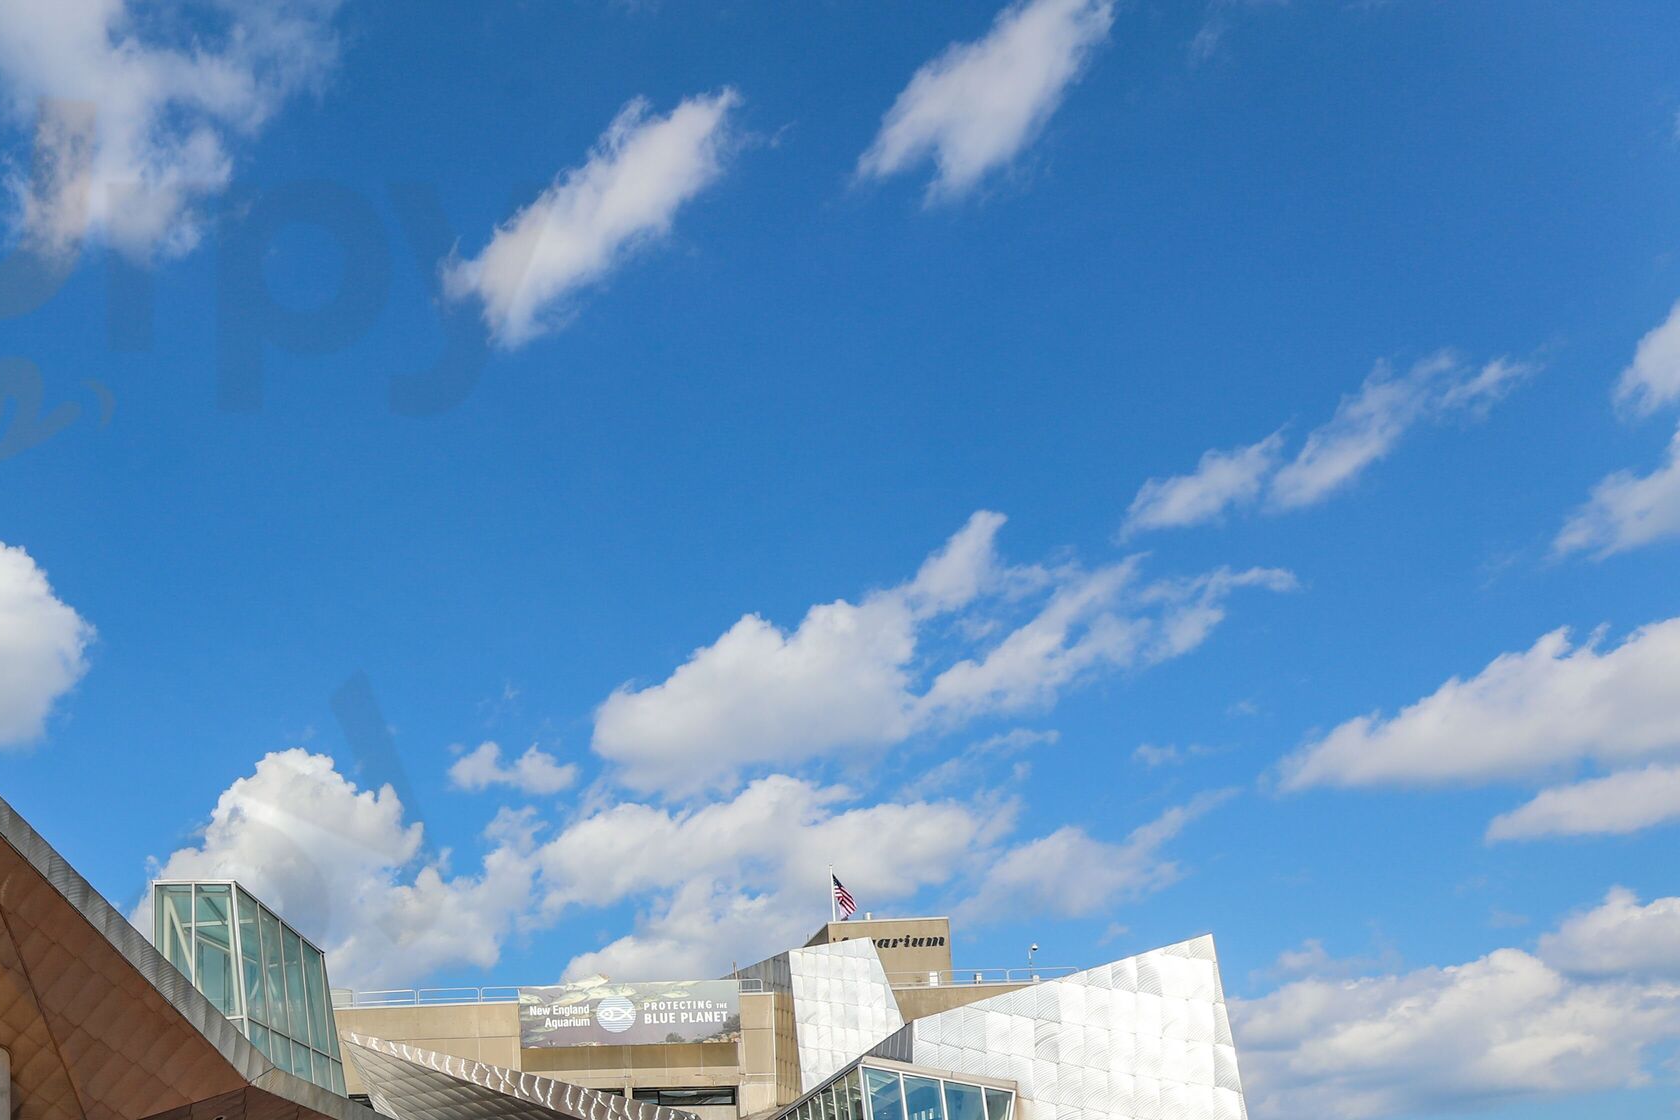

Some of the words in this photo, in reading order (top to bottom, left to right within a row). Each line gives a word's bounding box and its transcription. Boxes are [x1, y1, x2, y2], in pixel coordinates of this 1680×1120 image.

[529, 1005, 550, 1016] New
[553, 1003, 590, 1017] England
[643, 1000, 713, 1011] PROTECTING
[544, 1017, 591, 1029] Aquarium
[644, 1012, 676, 1025] BLUE
[680, 1011, 728, 1023] PLANET
